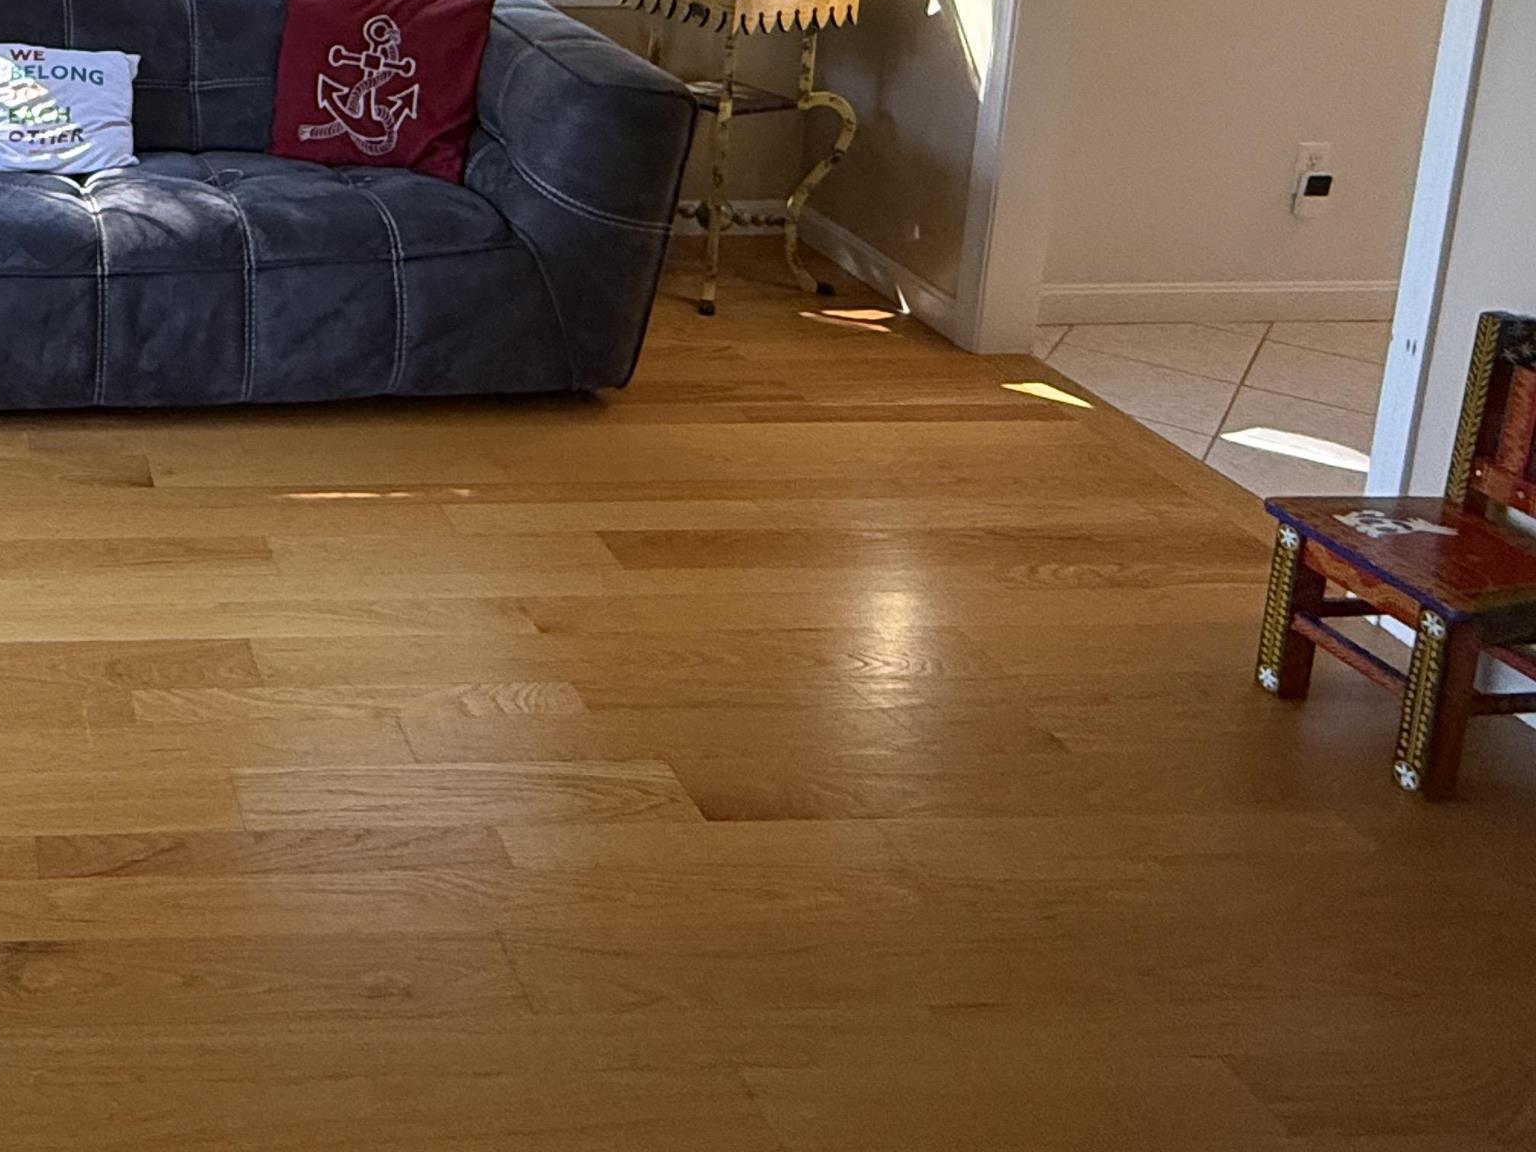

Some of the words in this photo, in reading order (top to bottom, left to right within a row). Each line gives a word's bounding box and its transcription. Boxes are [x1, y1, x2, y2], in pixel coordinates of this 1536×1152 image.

[9, 49, 46, 61] WE
[11, 65, 104, 86] BELONG
[8, 106, 71, 124] EACH
